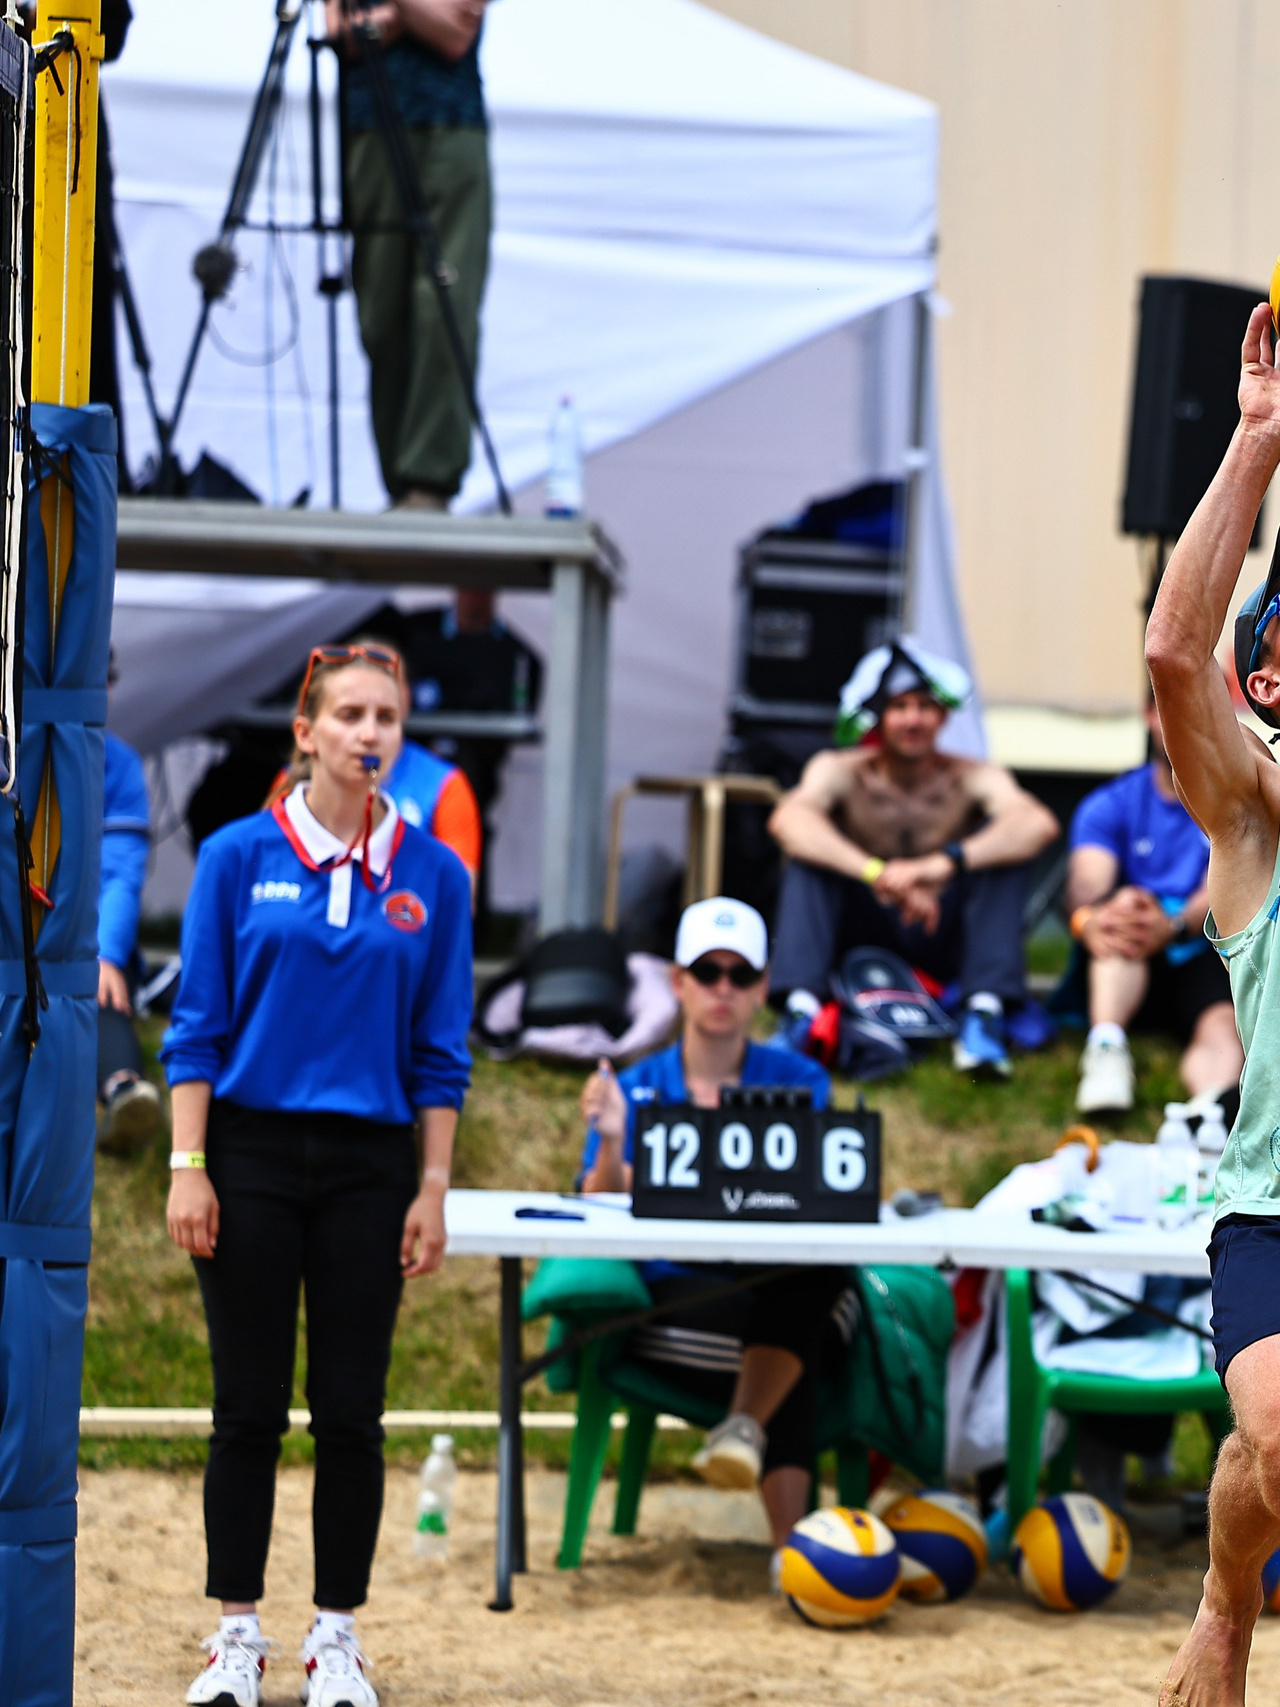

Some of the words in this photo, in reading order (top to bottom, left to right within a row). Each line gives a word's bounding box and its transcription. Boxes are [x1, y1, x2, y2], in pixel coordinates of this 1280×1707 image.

[642, 1122, 700, 1188] 12
[718, 1121, 754, 1171] 0
[762, 1121, 798, 1172] 0
[821, 1126, 867, 1192] 6
